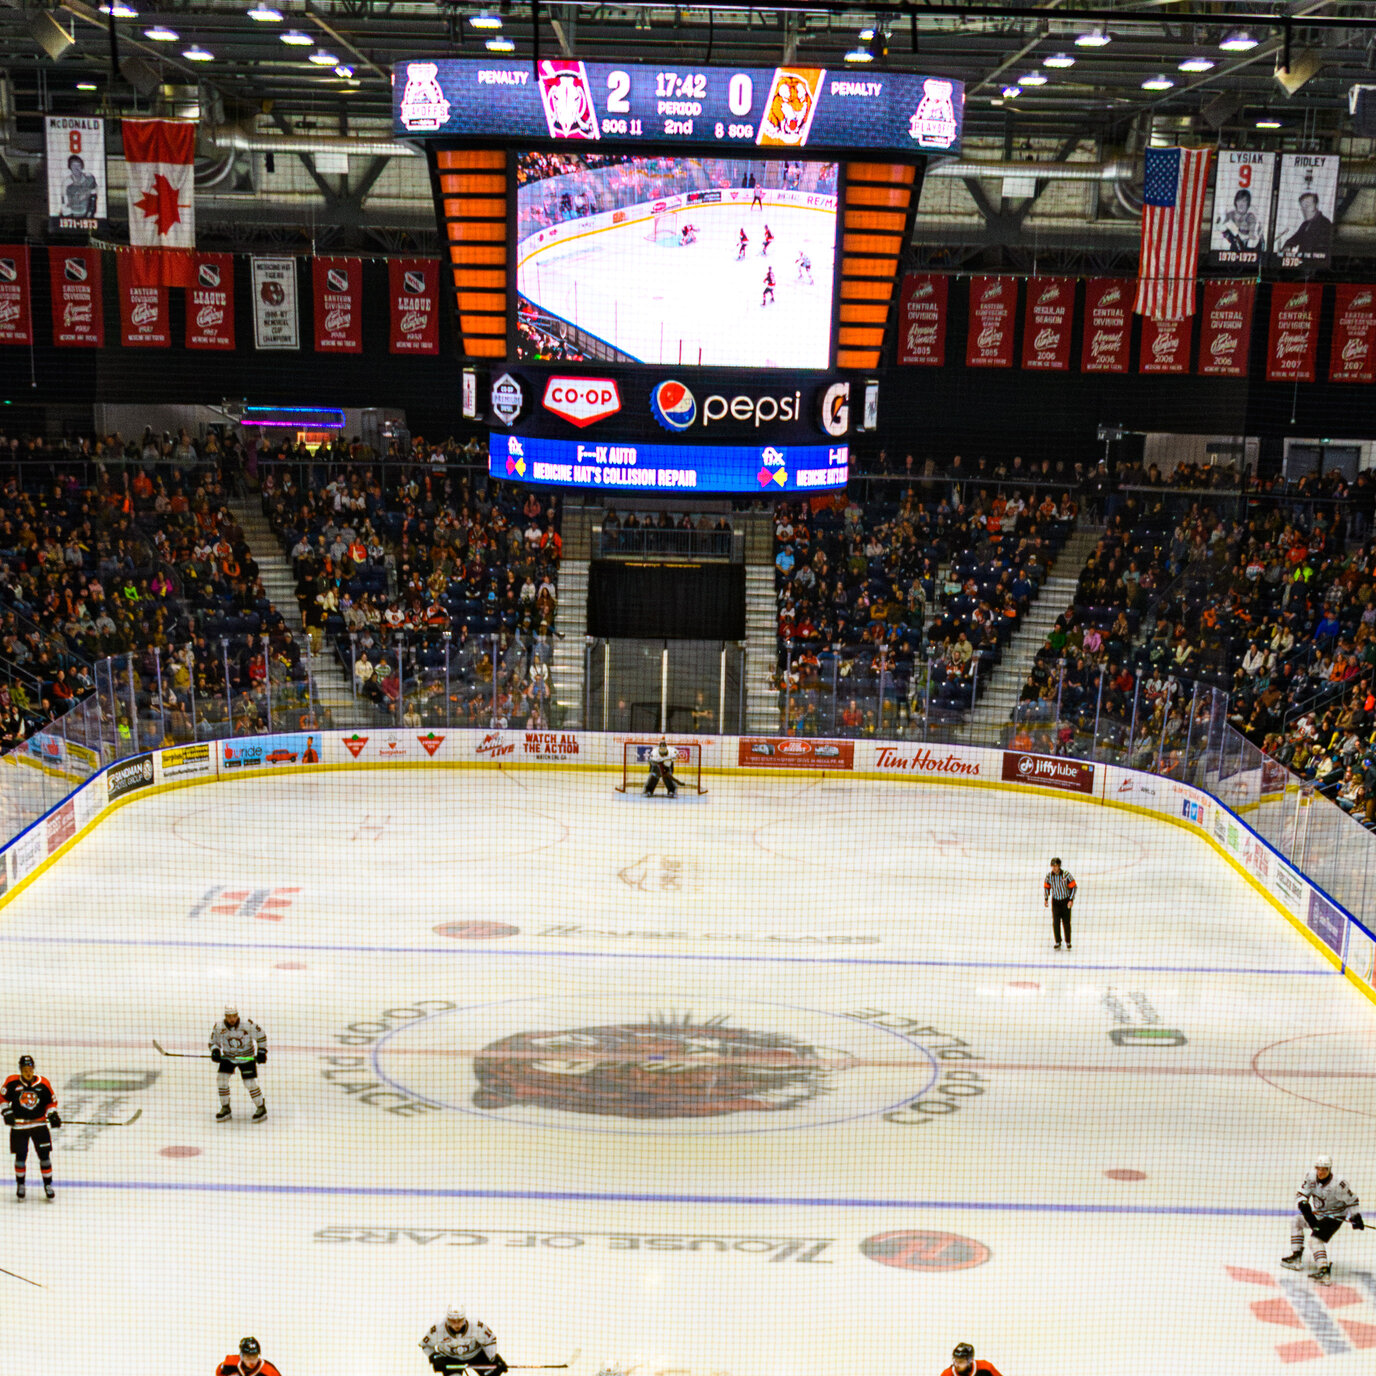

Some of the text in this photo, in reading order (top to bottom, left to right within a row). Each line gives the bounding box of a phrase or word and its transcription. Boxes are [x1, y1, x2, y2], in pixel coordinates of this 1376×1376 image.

[478, 70, 529, 85] PENALTY
[655, 73, 707, 98] 17:42
[607, 71, 631, 113] 2
[728, 73, 753, 116] 0
[831, 81, 882, 97] PENALTY
[658, 100, 702, 115] PERIOD
[50, 118, 100, 130] McDONALD
[601, 119, 642, 135] SOG 11
[664, 118, 694, 134] 2nd
[714, 122, 754, 138] 8 SOG
[69, 130, 82, 154] 8
[1229, 153, 1264, 164] LYSIAK
[1294, 156, 1326, 167] RIDLEY
[1238, 164, 1252, 188] 9
[194, 291, 227, 306] LEAGUE
[398, 297, 431, 311] LEAGUE
[703, 391, 801, 427] pepsi
[609, 446, 638, 465] AUTO
[533, 462, 698, 487] MEDICINE HAT'S COLLISION REPAIR
[524, 733, 578, 744] WATCH ALL
[491, 744, 516, 758] LIVE
[524, 743, 580, 755] THE ACTION
[875, 747, 908, 770] Tim
[912, 747, 980, 776] Hortons
